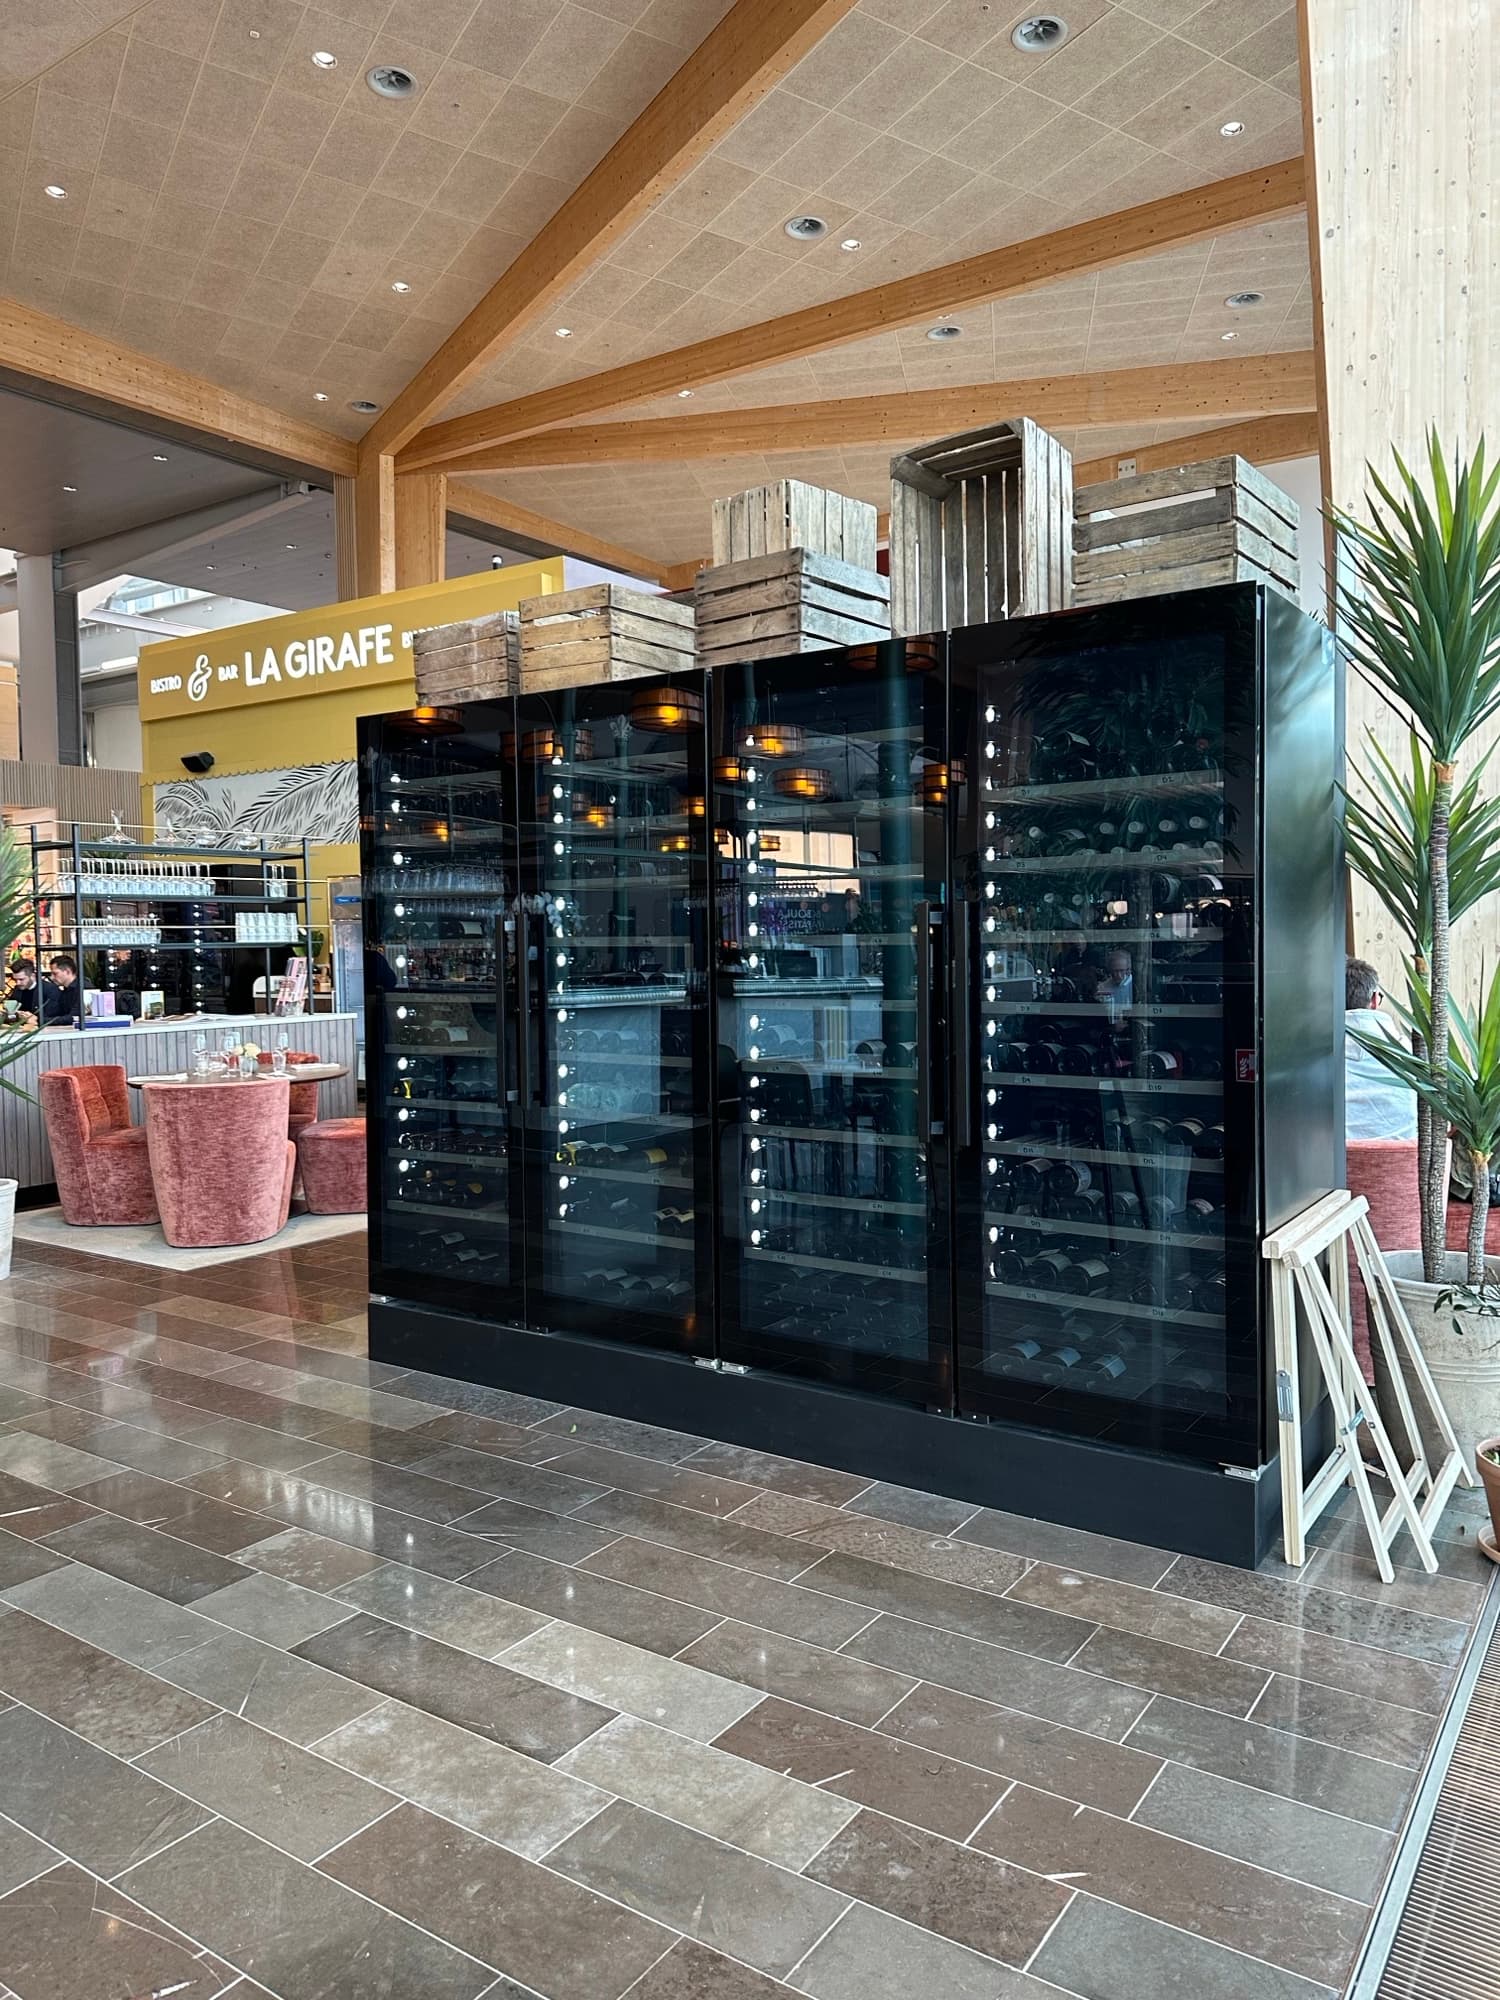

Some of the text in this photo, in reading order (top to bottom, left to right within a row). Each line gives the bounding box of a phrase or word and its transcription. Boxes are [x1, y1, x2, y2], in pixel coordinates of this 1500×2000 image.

[150, 675, 182, 694] BISTRO
[187, 654, 213, 702] &
[218, 664, 239, 682] BAR
[244, 647, 282, 687] LA
[284, 624, 394, 679] GIRAFE
